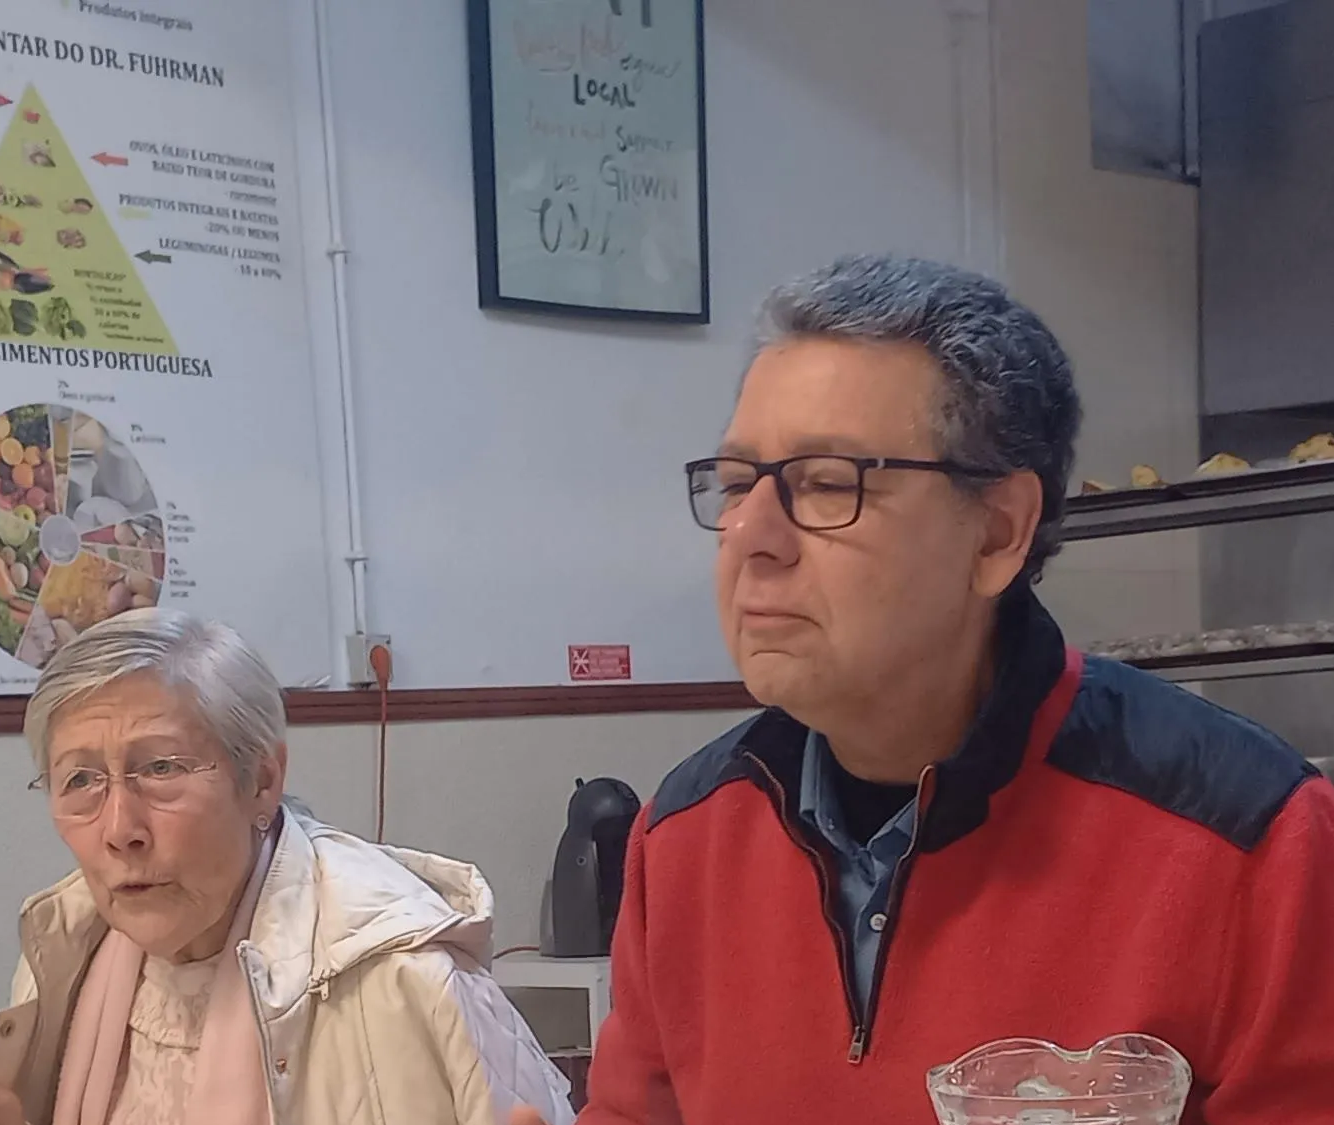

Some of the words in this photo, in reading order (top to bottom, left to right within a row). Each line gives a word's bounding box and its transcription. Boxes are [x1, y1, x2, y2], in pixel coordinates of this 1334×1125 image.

[54, 40, 85, 63] DO
[89, 46, 125, 71] DR.
[128, 52, 225, 88] FUHRMAN
[574, 73, 637, 110] LOCAL
[119, 193, 176, 211] PRODUTOS
[92, 350, 213, 378] PORTUGUESA
